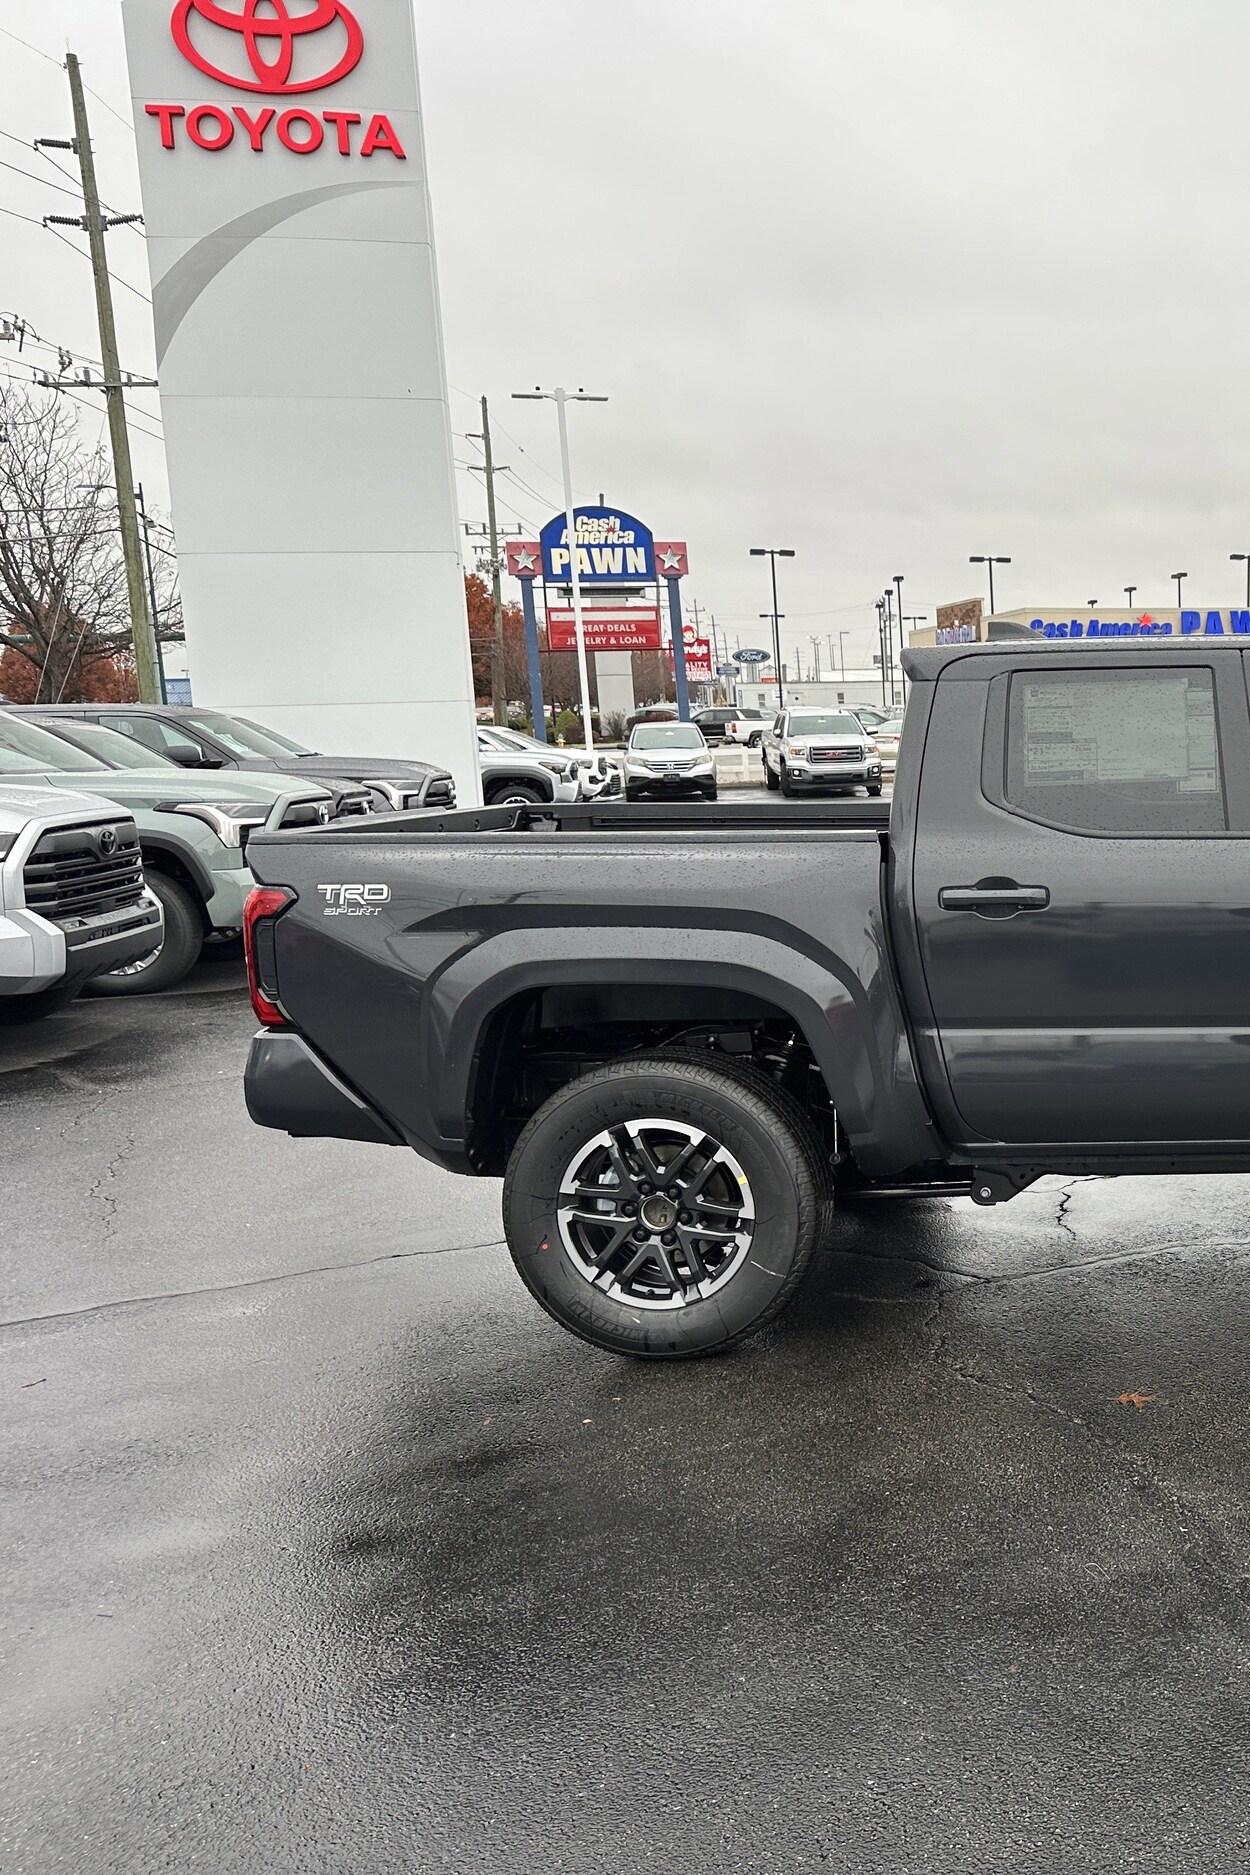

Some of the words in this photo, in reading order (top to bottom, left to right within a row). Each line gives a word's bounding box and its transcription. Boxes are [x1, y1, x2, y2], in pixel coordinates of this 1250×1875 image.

[145, 104, 407, 160] TOYOTA
[575, 516, 621, 532] Cash
[560, 529, 635, 545] America
[550, 547, 647, 574] PAWN
[574, 624, 604, 632] REAT
[607, 624, 636, 632] DEALS
[1030, 619, 1083, 638] Cash
[1086, 619, 1173, 636] America
[566, 637, 606, 645] JEELRY
[740, 651, 764, 661] Ford
[317, 884, 391, 908] TRD
[323, 907, 382, 915] SPORT
